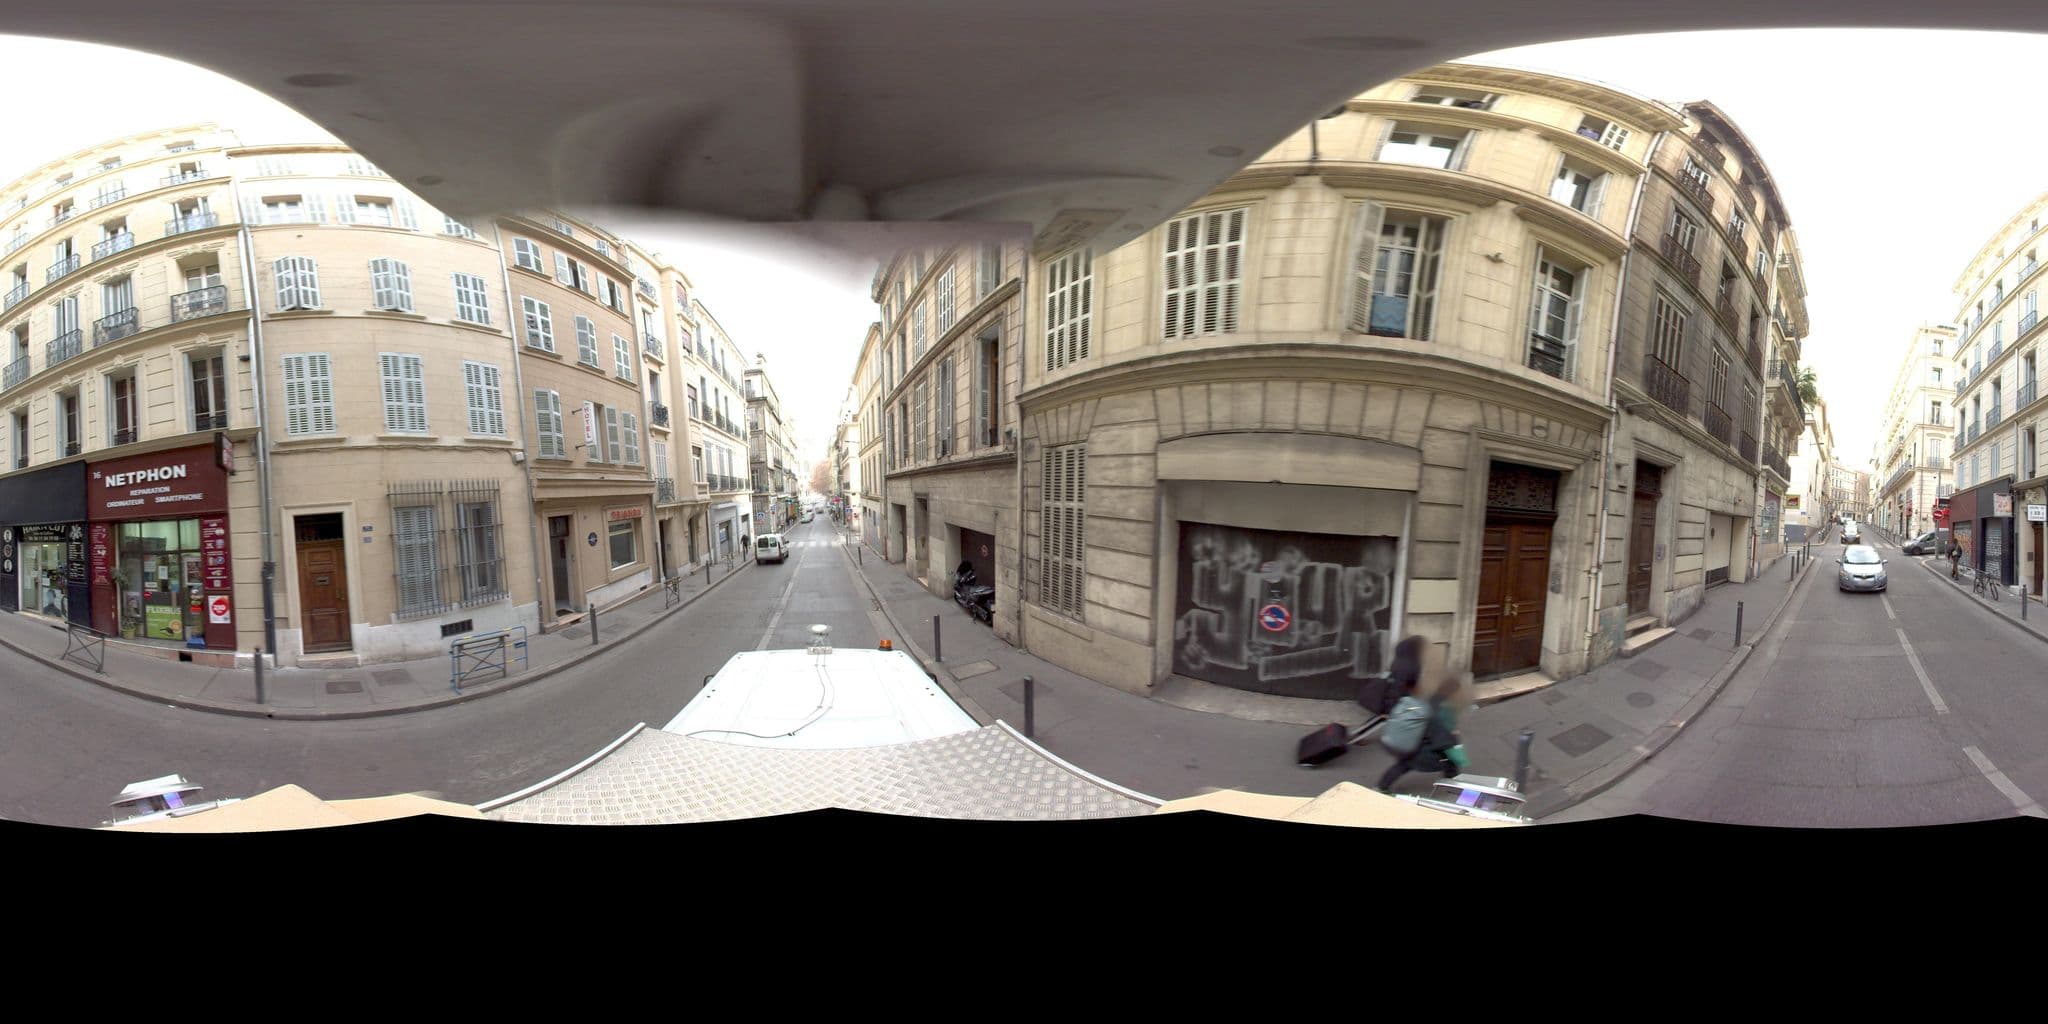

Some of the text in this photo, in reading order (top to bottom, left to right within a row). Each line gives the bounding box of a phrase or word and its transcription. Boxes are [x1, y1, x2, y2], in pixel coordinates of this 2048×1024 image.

[105, 464, 187, 488] NETPHON
[106, 493, 204, 508] ORDINATEUR SMARTPHONE
